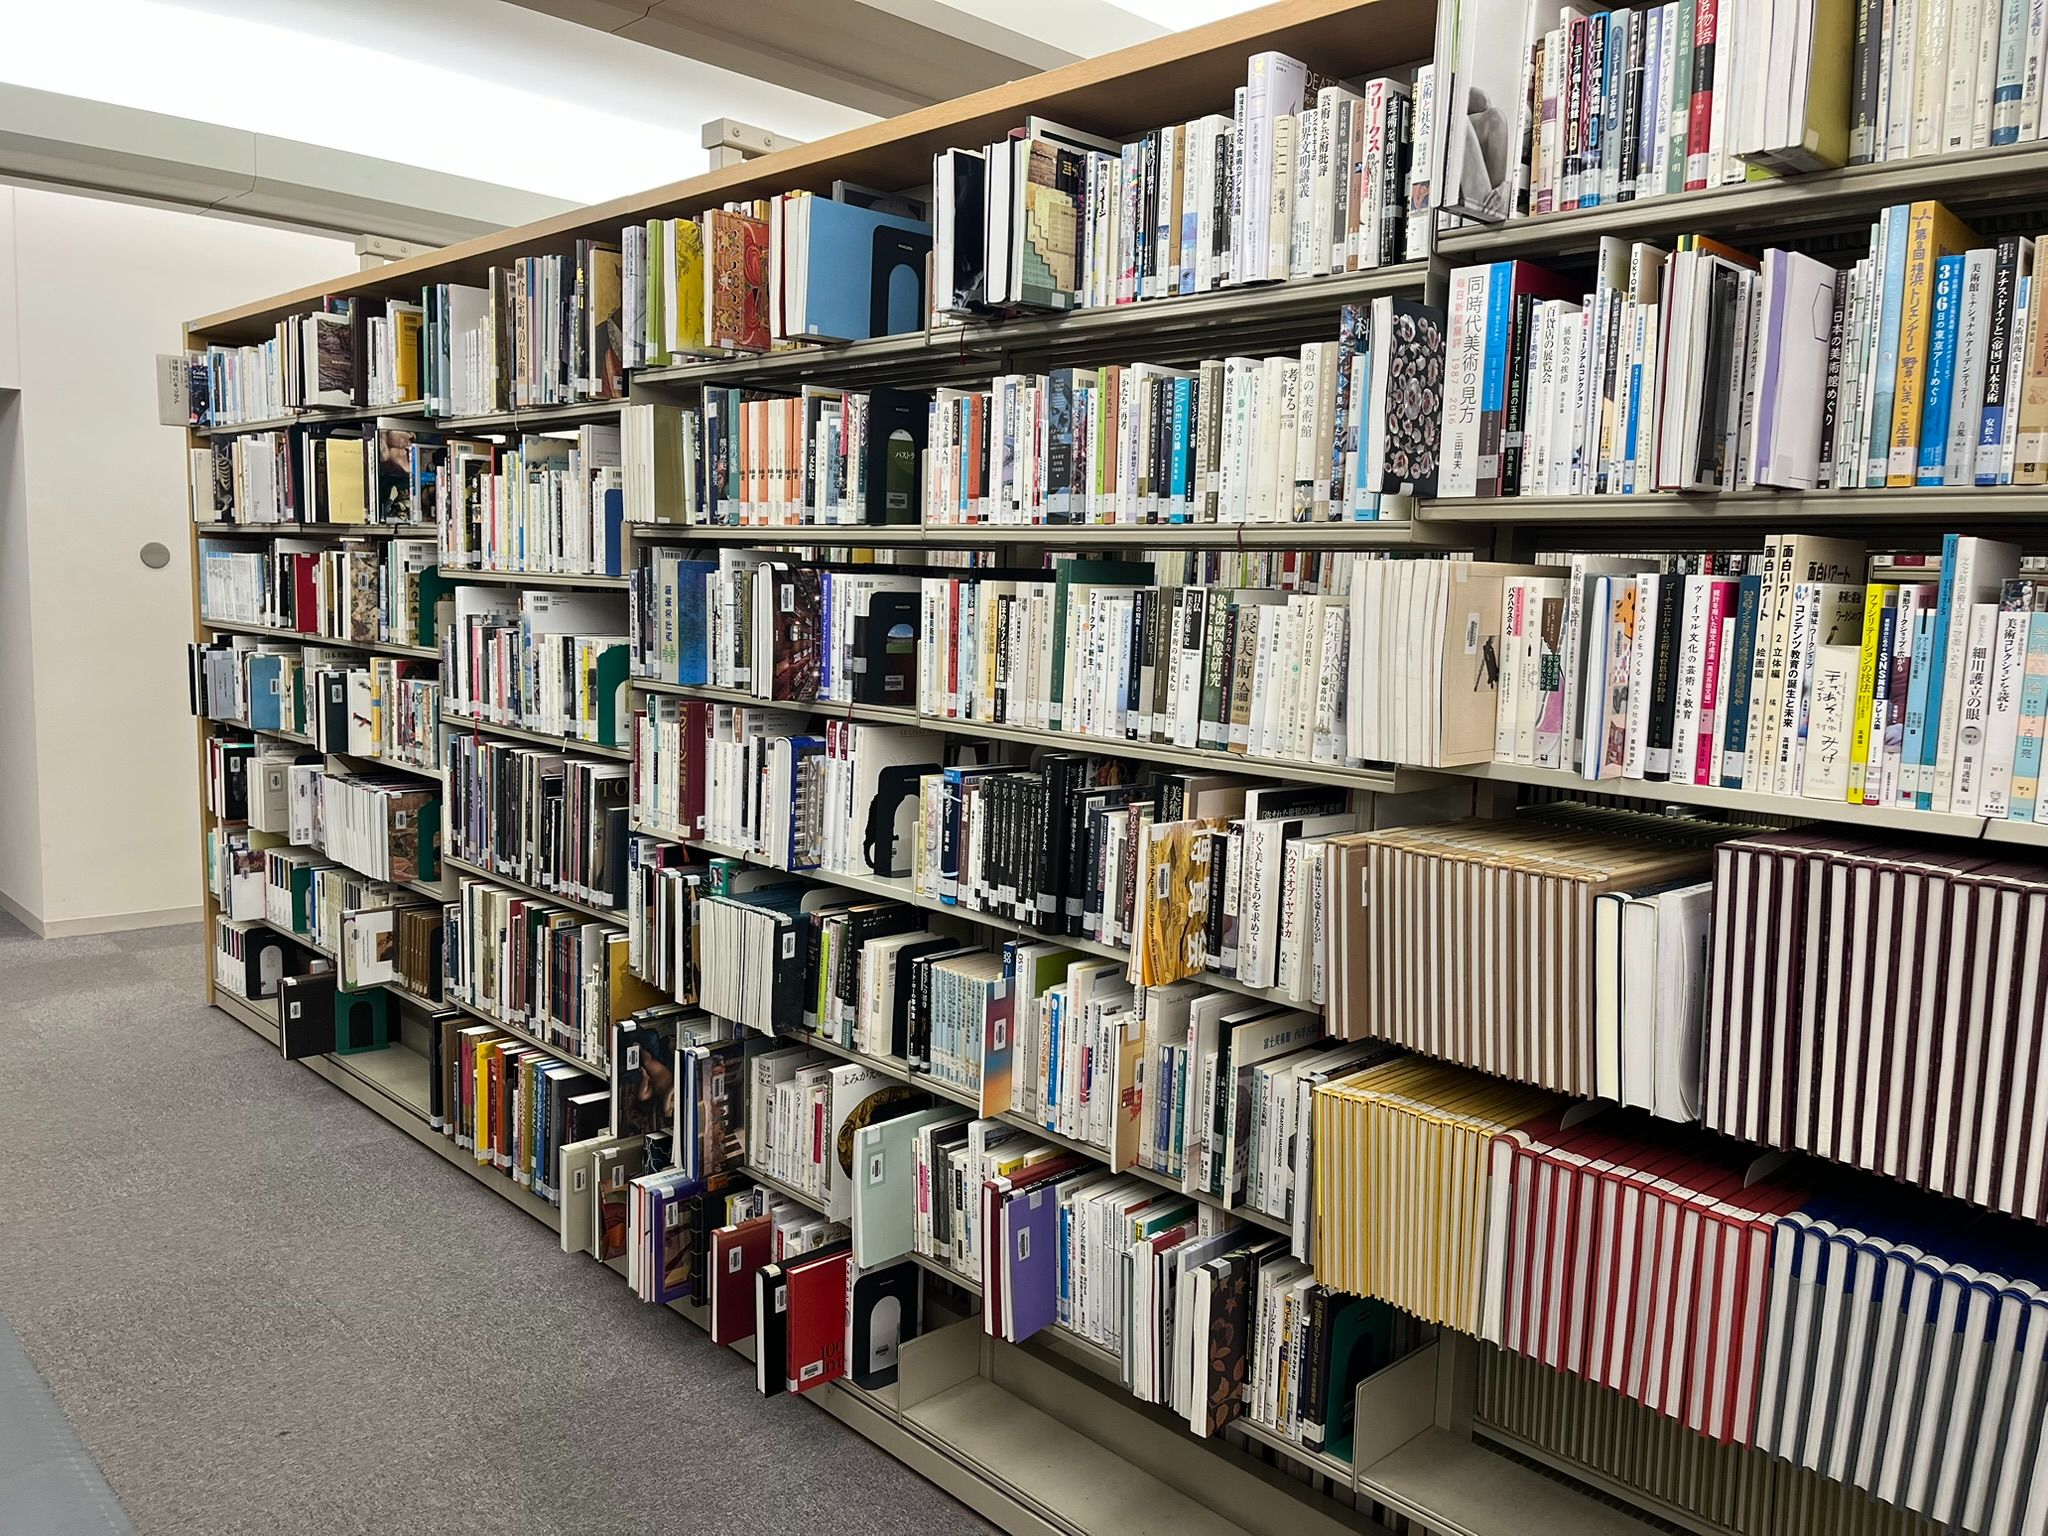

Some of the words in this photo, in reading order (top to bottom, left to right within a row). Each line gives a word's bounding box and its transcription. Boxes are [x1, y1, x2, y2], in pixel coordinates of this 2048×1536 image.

[1368, 82, 1383, 153] フリークス
[1459, 275, 1484, 424] 同時代美術の見方
[1542, 305, 1557, 384] 百貨店の展覧会
[1560, 326, 1572, 384] 展覧会の挨拶
[1825, 310, 1844, 426] 日本の美術館めぐり
[1286, 368, 1299, 411] 考える
[1301, 348, 1316, 438] 奇想の美術館
[1508, 356, 1521, 431] アート鑑賞の玉手箱
[1453, 432, 1464, 470] 三田晴夫
[1759, 545, 1777, 621] 面白いアート
[1776, 545, 1794, 621] 面白いアート
[1225, 615, 1234, 658] アウラの方へ
[1635, 578, 1649, 676] 芸術する人びとをつくる
[1683, 583, 1704, 720] ヴァイマル文化の芸術と教育
[1753, 647, 1766, 679] 絵画編
[1770, 647, 1782, 679] 立体編
[1997, 617, 2017, 712] 美術コレクションを読む
[1783, 604, 1806, 728] コンテンツ教育の誕生と未来
[1965, 647, 1987, 721] 細川護立の眼
[2021, 727, 2033, 759] 古田亮
[1250, 831, 1264, 942] 古く美しきものを求めて
[1284, 848, 1298, 939] ハウス・オブ・ヤマナカ
